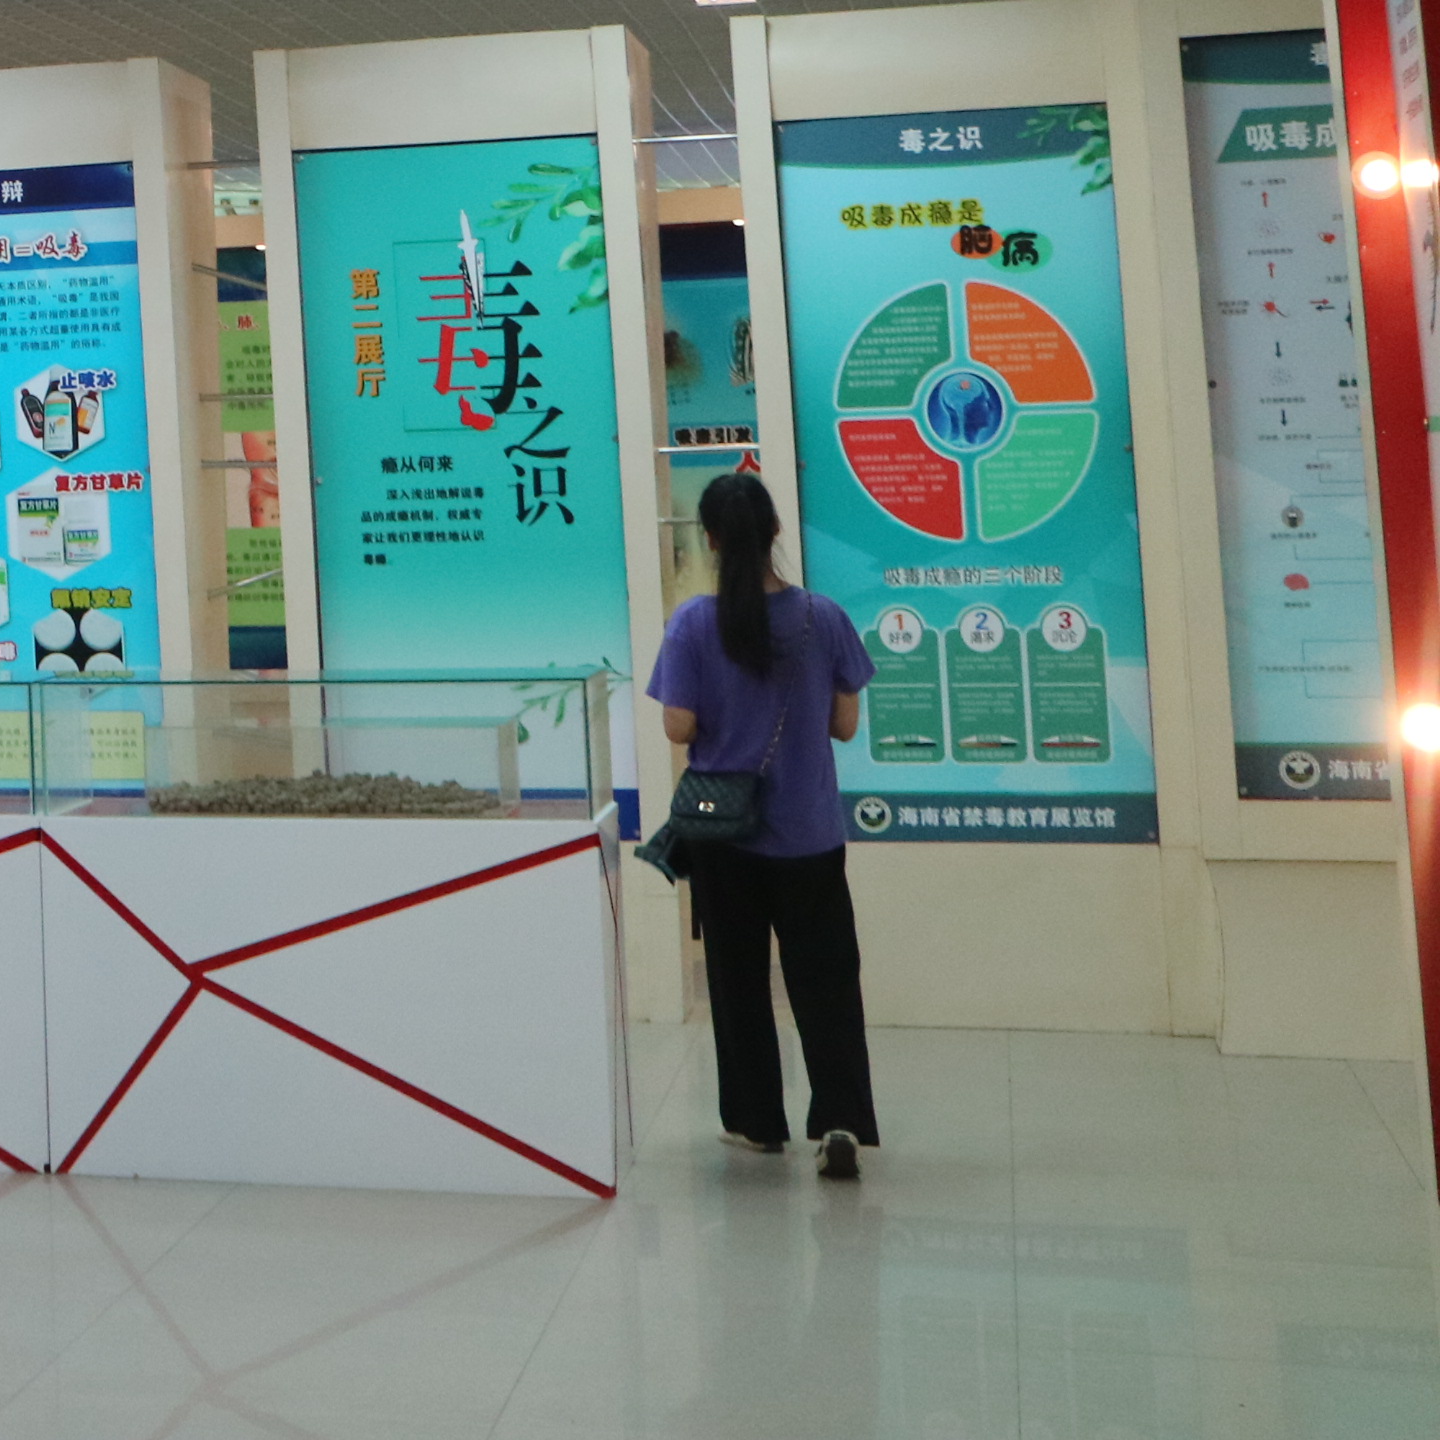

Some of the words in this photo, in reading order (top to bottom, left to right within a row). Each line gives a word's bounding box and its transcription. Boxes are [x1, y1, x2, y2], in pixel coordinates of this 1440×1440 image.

[899, 126, 984, 154] 毒之识
[840, 199, 985, 231] 吸毒成瘾是
[350, 268, 386, 397] 第二展厅
[380, 454, 454, 474] 瘾从何来
[55, 473, 143, 492] 复方甘草片
[883, 565, 1064, 587] 吸毒成瘾的三个阶段
[893, 614, 905, 631] 1
[975, 612, 990, 631] 2
[1058, 611, 1073, 630] 3
[898, 806, 1116, 829] 海南省禁毒教育展览馆
